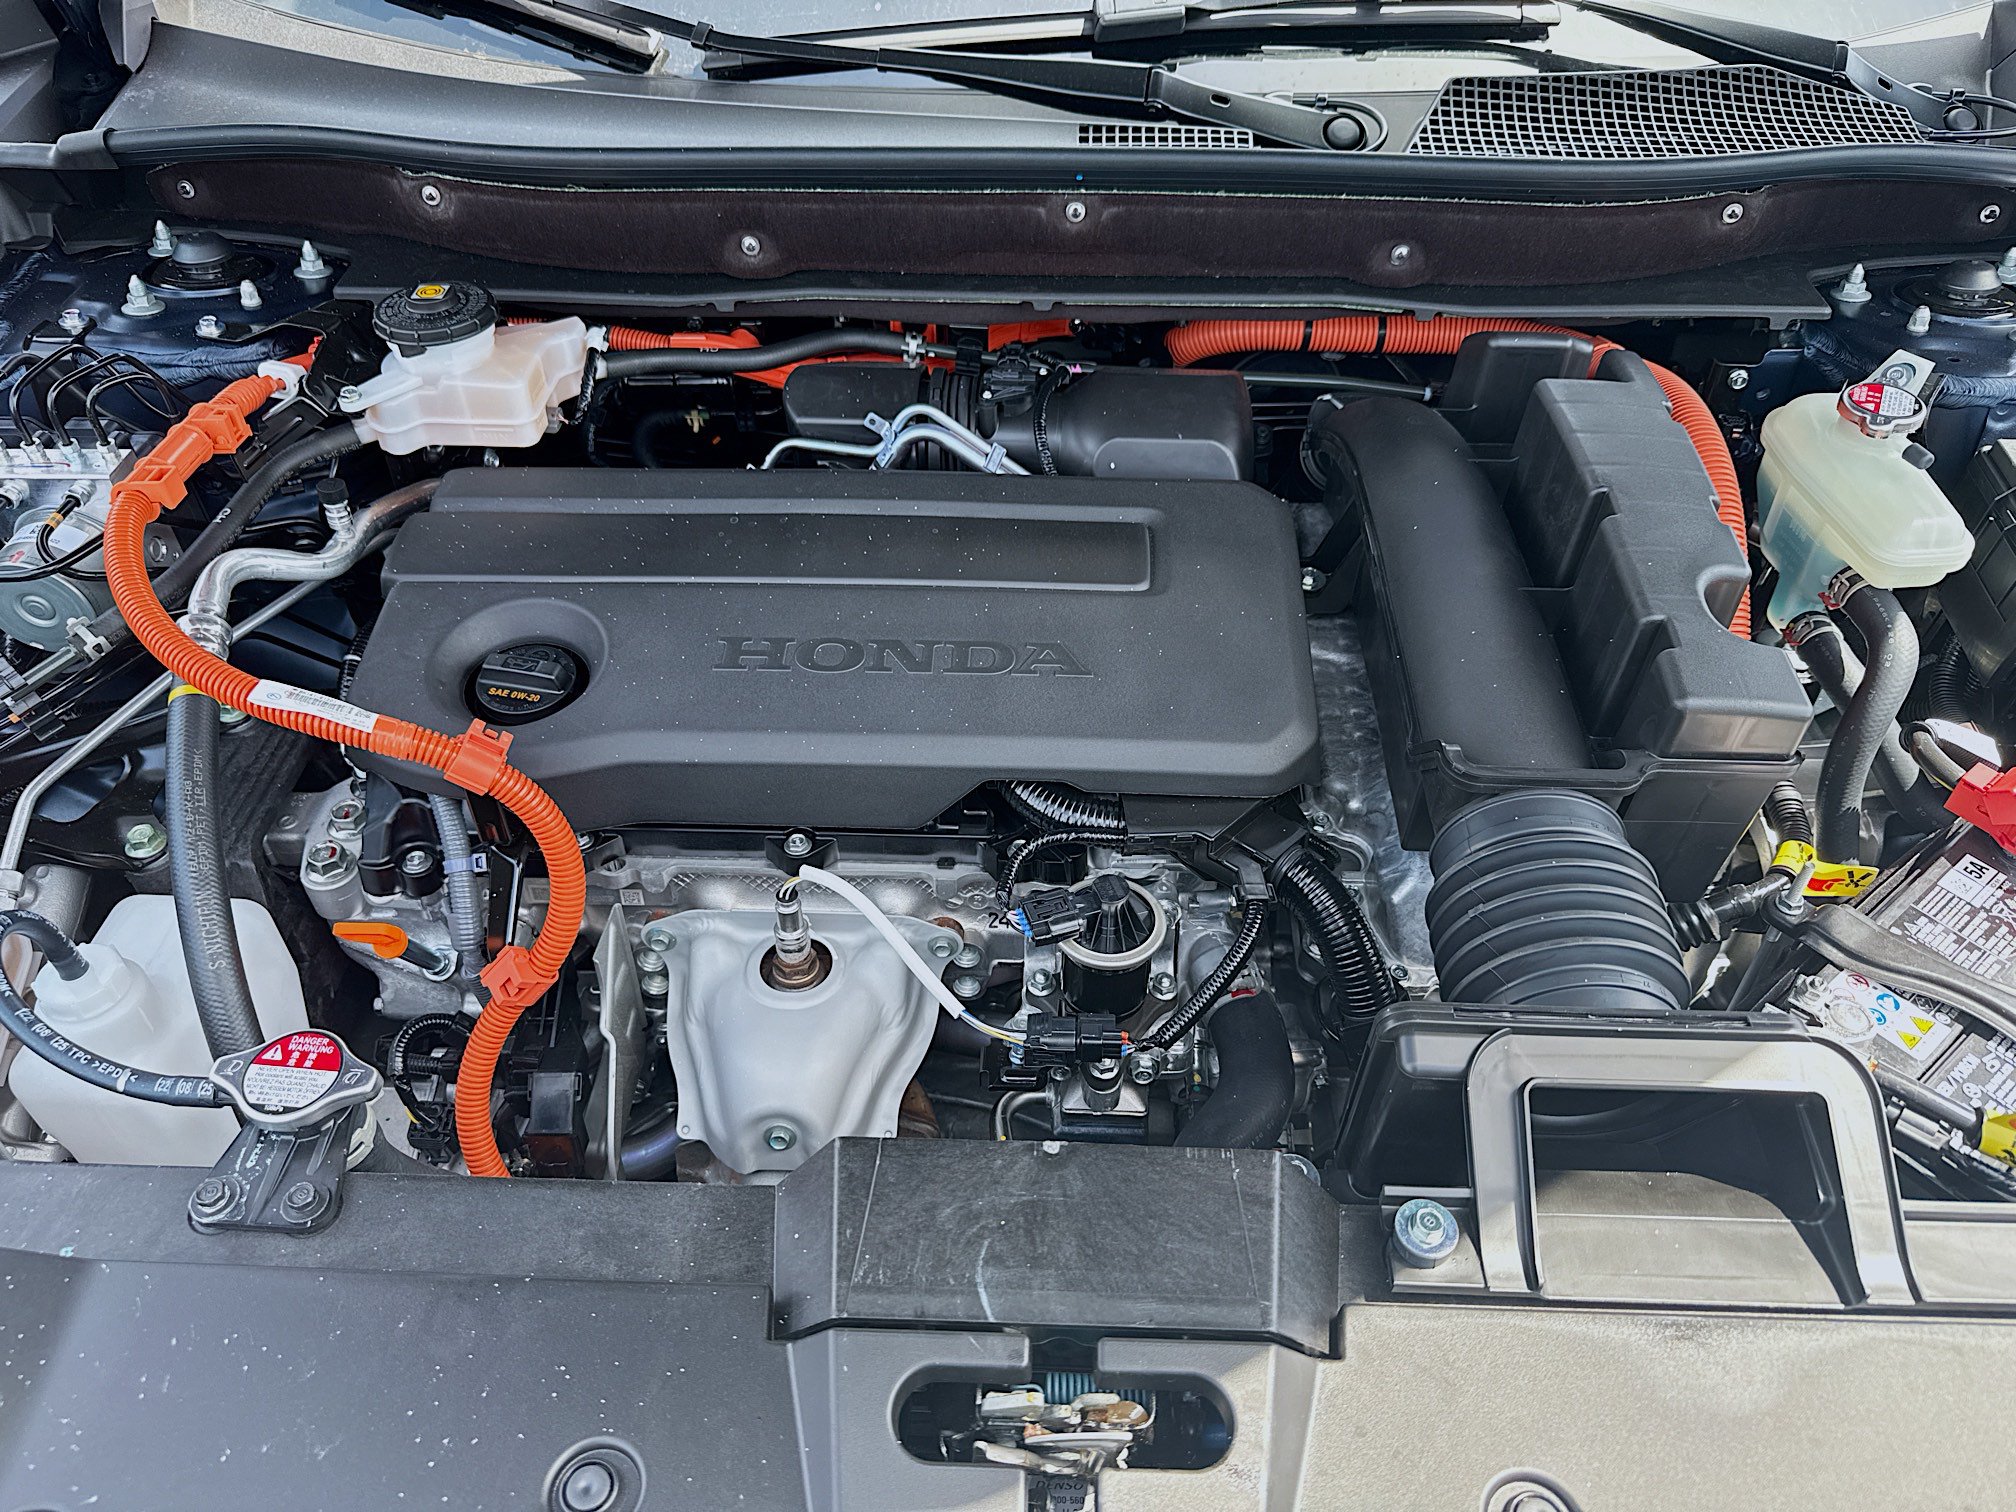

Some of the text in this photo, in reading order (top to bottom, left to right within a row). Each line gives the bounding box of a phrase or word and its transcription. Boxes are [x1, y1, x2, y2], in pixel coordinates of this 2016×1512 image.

[712, 636, 1094, 678] HONDA
[488, 687, 541, 702] SAE 0W-20
[1963, 860, 1990, 880] 5A
[988, 911, 1010, 929] 24
[288, 1042, 335, 1055] WARNUNG
[291, 1035, 330, 1046] DANGER
[67, 1047, 92, 1064] TPC
